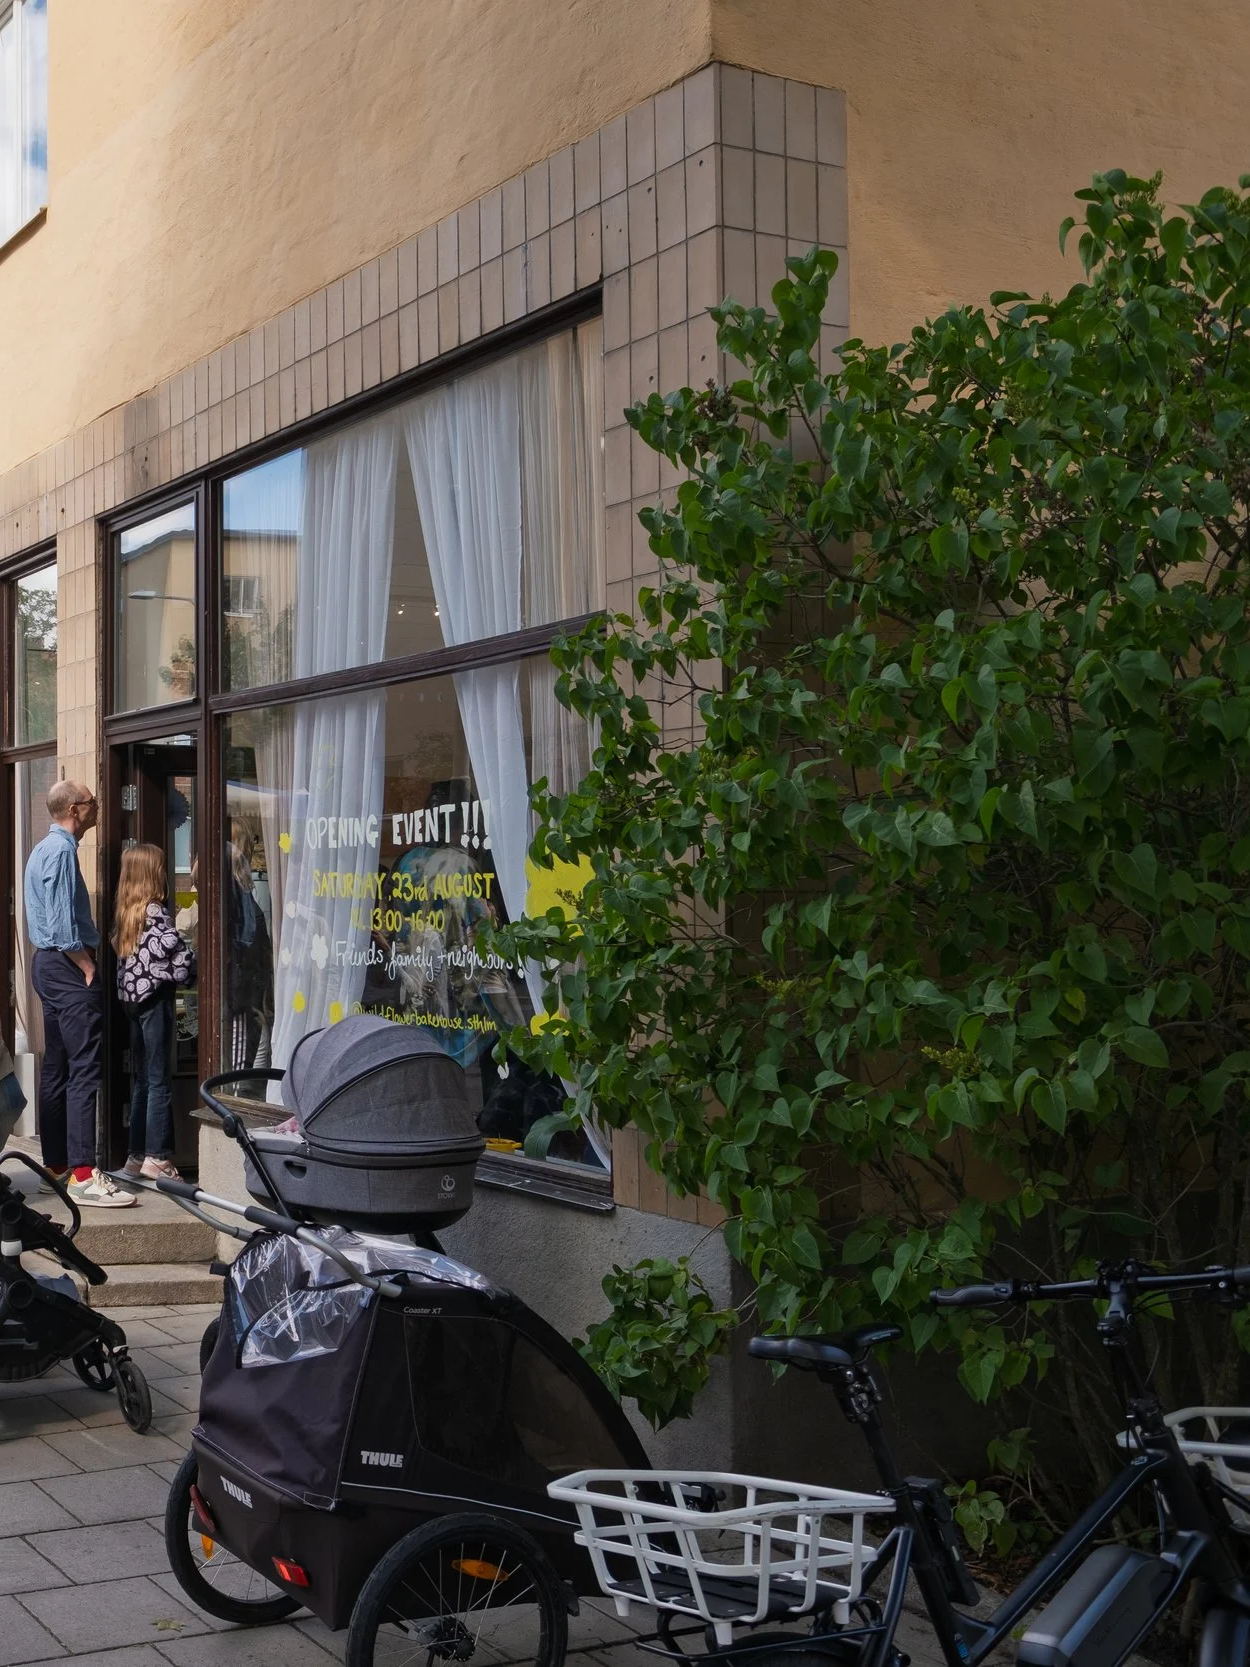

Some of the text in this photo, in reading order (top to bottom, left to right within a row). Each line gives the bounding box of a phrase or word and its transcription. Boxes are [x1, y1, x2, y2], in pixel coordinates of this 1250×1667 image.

[306, 813, 379, 850] OPENING
[433, 872, 495, 900] AUGUST
[403, 1306, 431, 1314] Coaster
[360, 1450, 404, 1468] THULE
[220, 1474, 253, 1509] THULE
